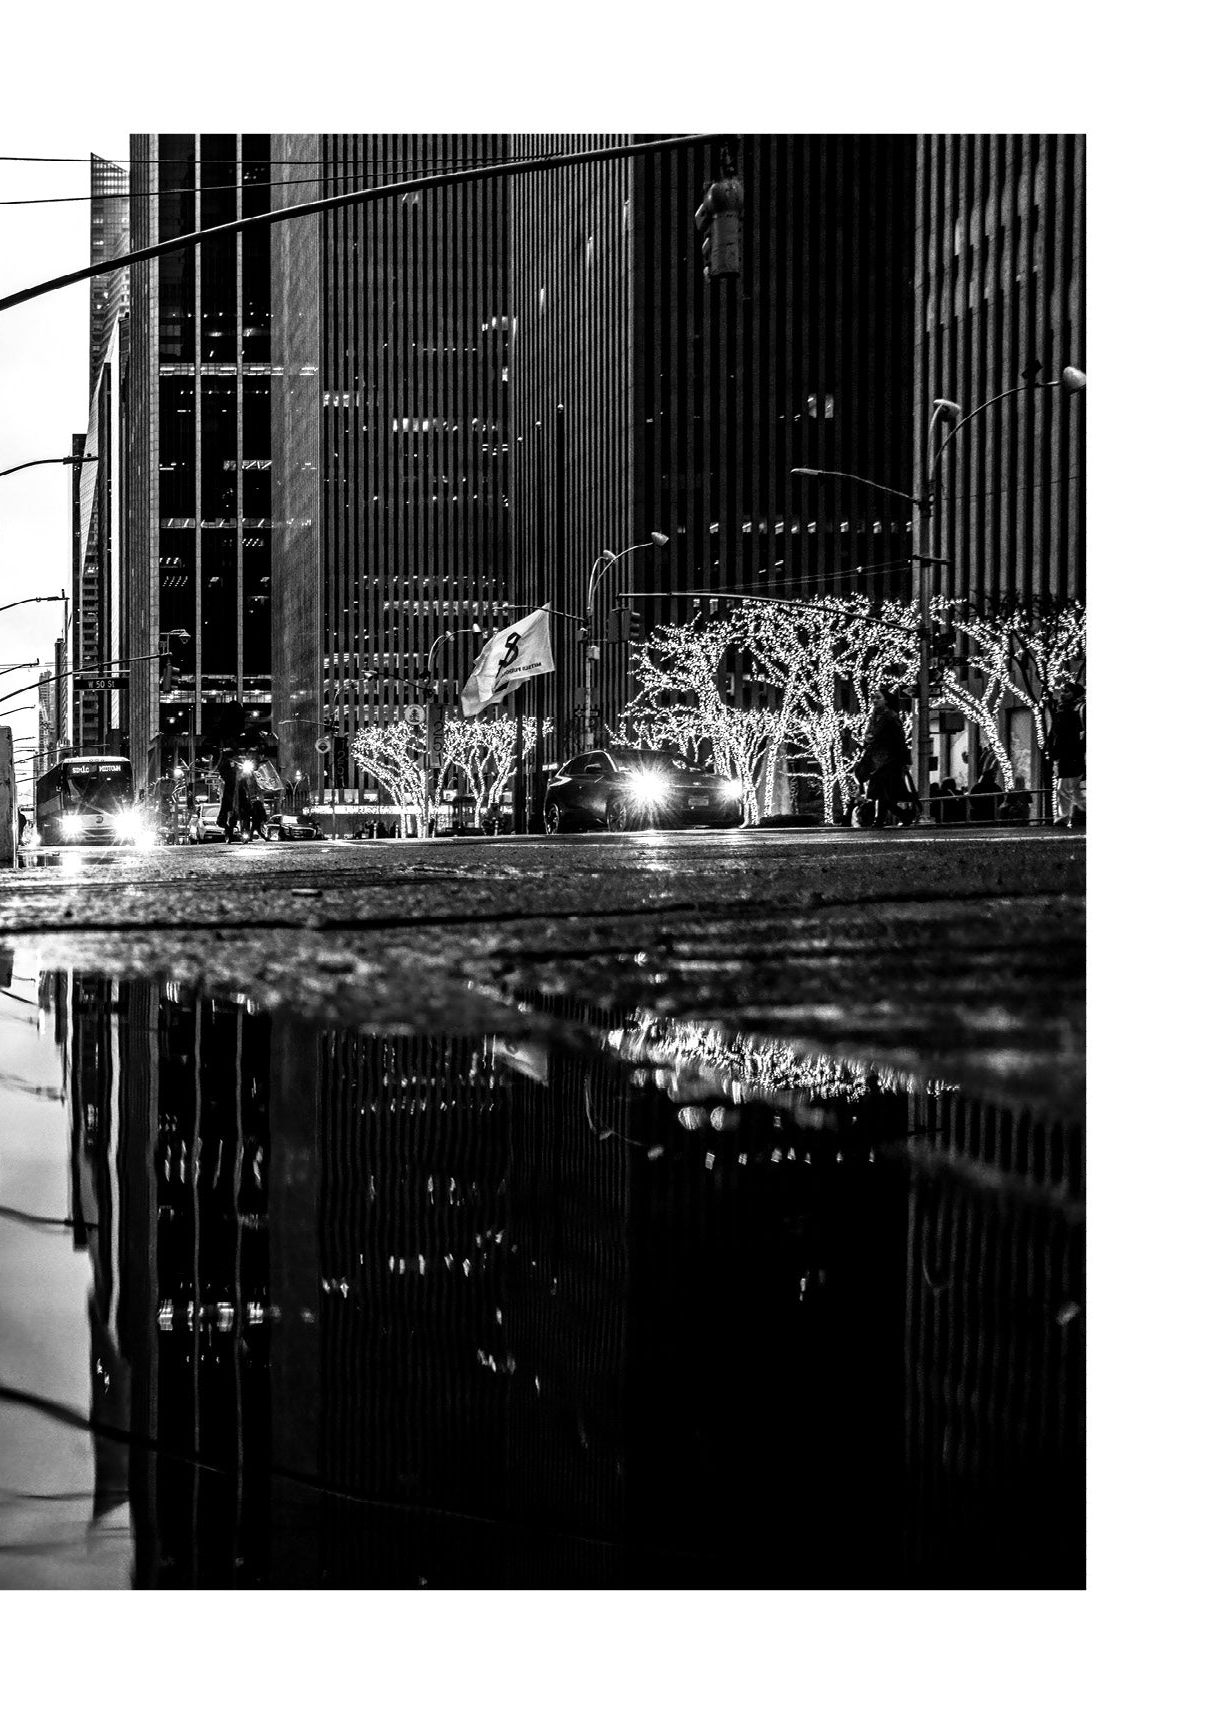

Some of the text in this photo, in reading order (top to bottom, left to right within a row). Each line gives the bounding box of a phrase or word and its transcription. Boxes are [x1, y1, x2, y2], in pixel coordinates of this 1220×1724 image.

[88, 680, 115, 689] W 50 St
